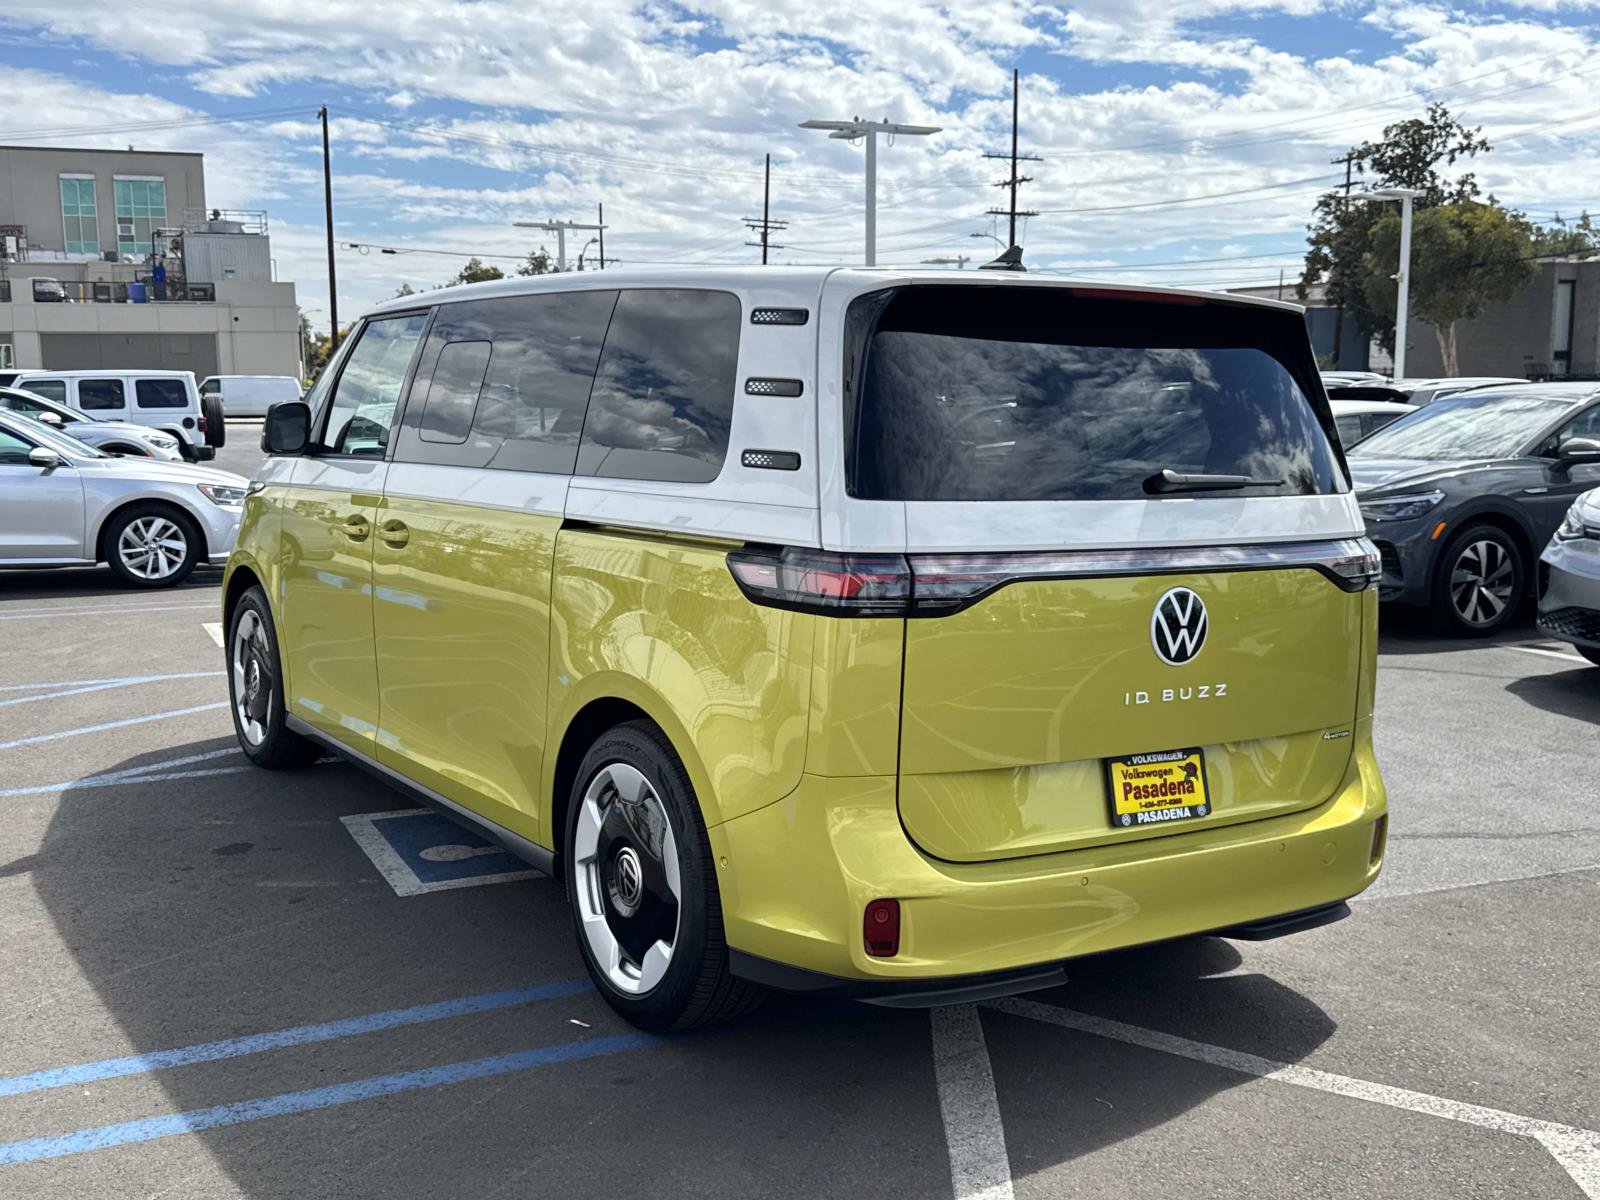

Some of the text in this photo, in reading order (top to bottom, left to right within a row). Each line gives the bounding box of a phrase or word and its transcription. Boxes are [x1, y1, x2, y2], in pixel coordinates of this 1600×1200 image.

[1151, 586, 1209, 666] VW
[1162, 683, 1227, 702] BUZZ
[1132, 752, 1183, 764] VOLKSWAGEN
[1121, 767, 1174, 780] Volkswagen
[1123, 778, 1195, 801] Pasadena
[1137, 807, 1191, 823] PASADENA
